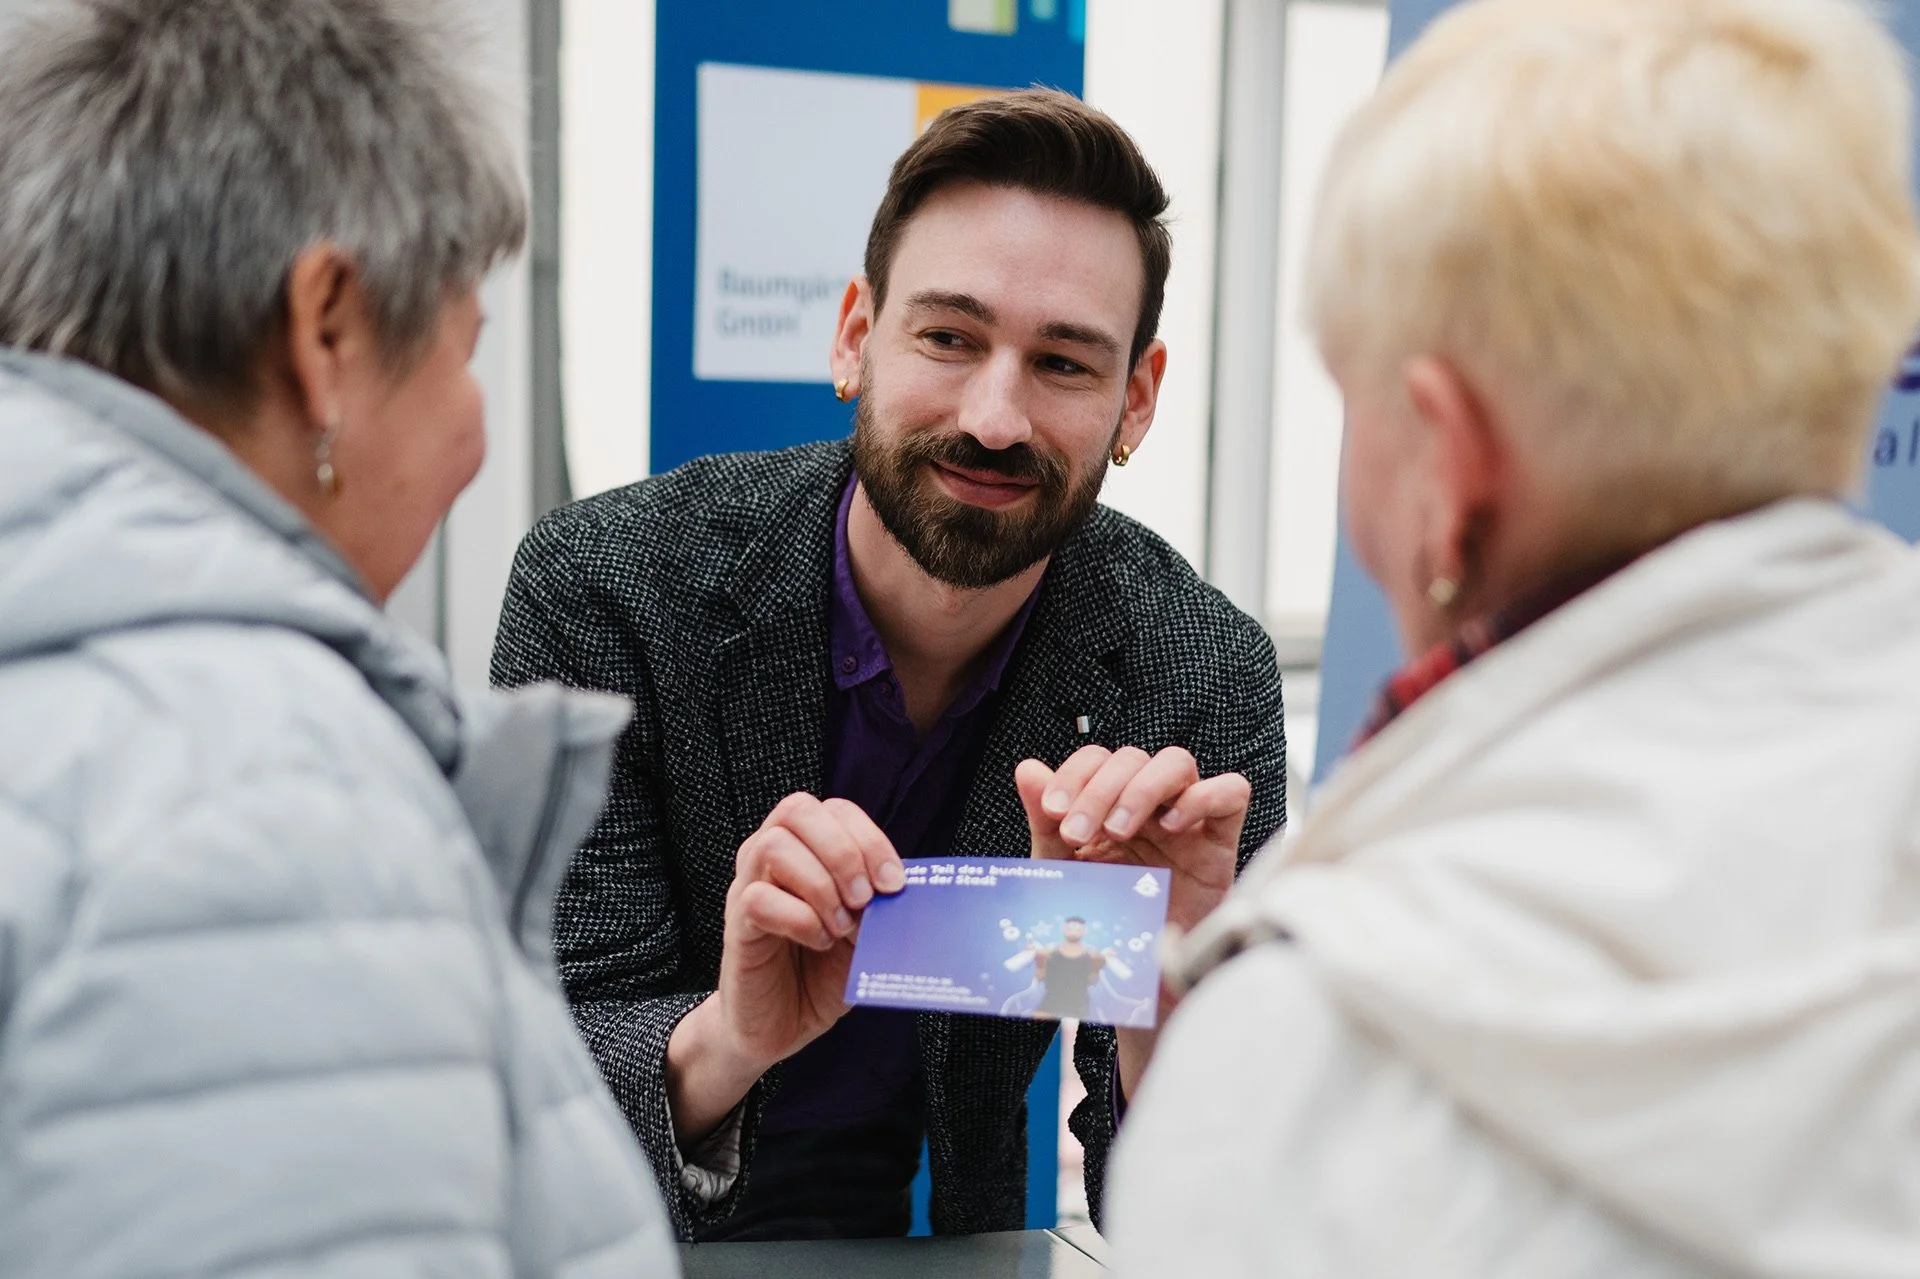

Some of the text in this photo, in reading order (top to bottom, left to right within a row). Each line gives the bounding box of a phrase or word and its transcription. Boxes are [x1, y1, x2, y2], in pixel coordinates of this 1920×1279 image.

[904, 864, 1064, 879] rde Teil des buntesten
[928, 874, 953, 886] der
[955, 875, 998, 887] Stadt
